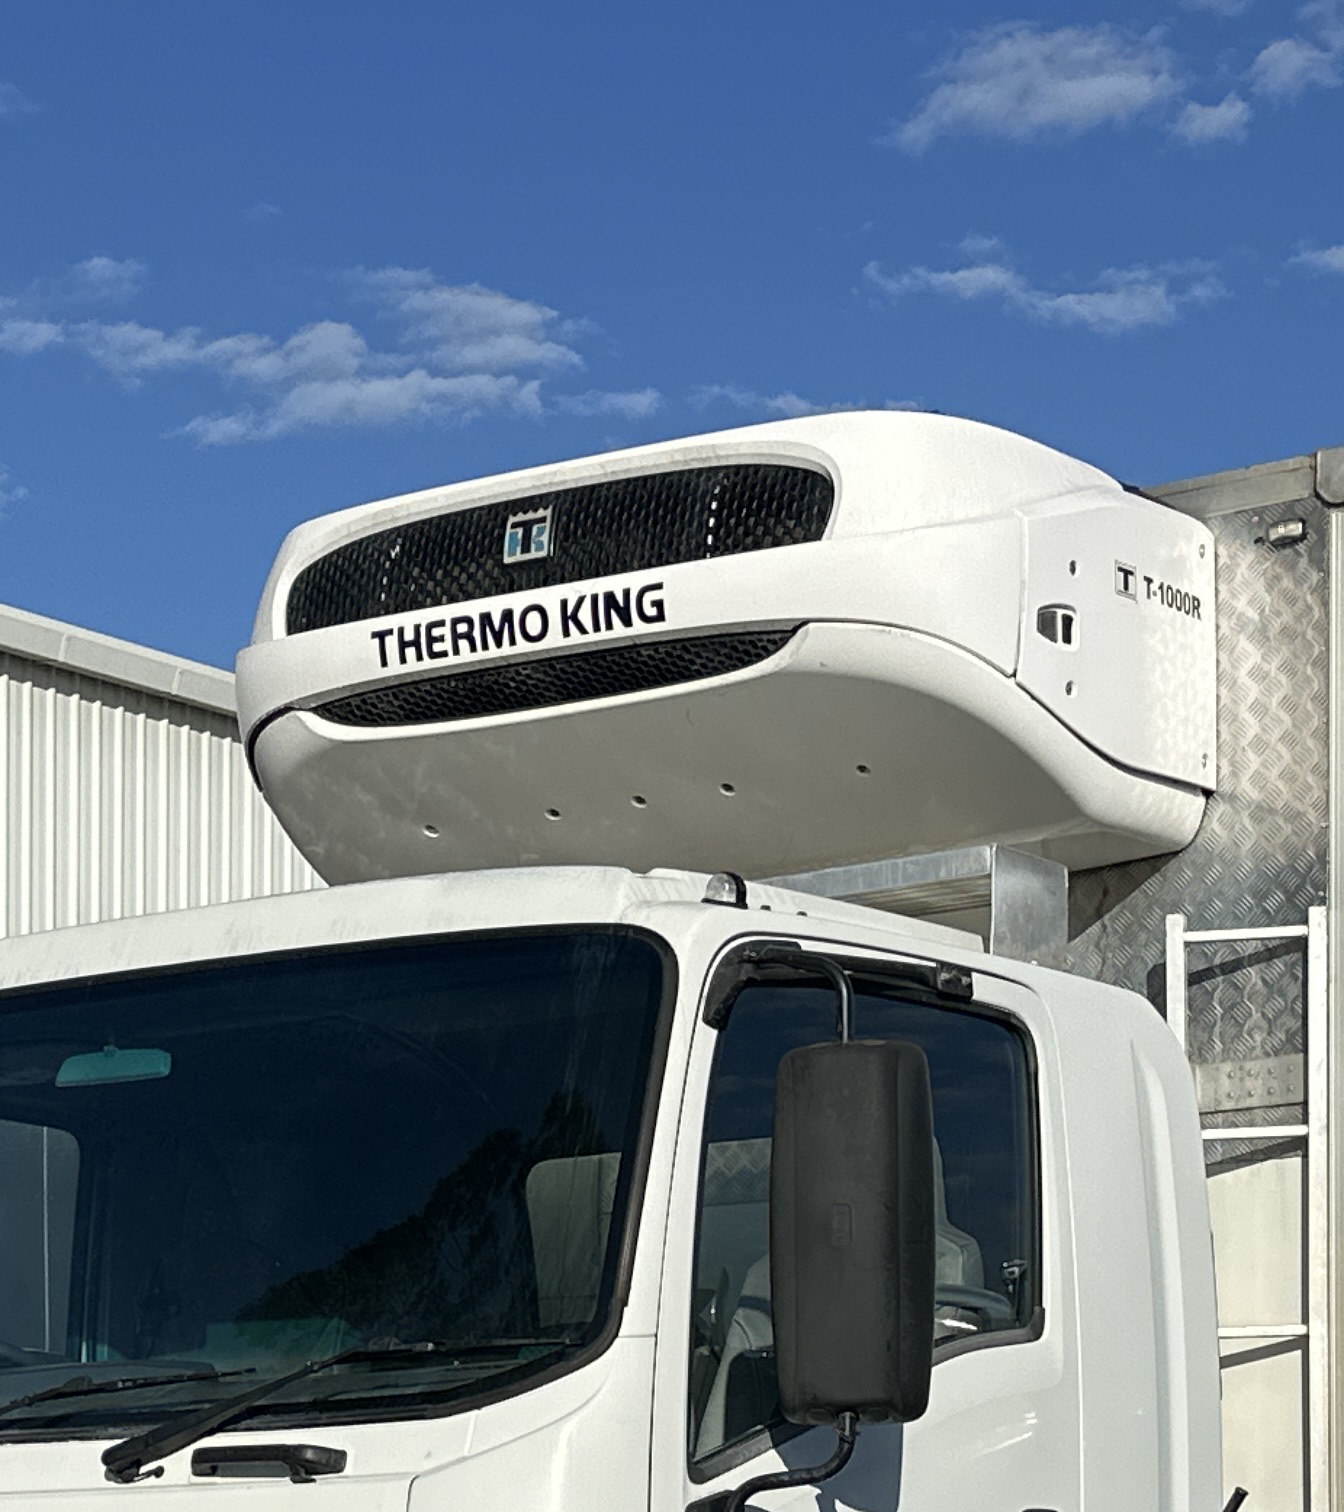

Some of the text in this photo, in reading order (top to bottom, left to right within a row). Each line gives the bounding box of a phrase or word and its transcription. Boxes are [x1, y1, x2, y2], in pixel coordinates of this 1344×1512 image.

[370, 582, 667, 668] THERMO KING
[1143, 575, 1202, 621] T-1000R
